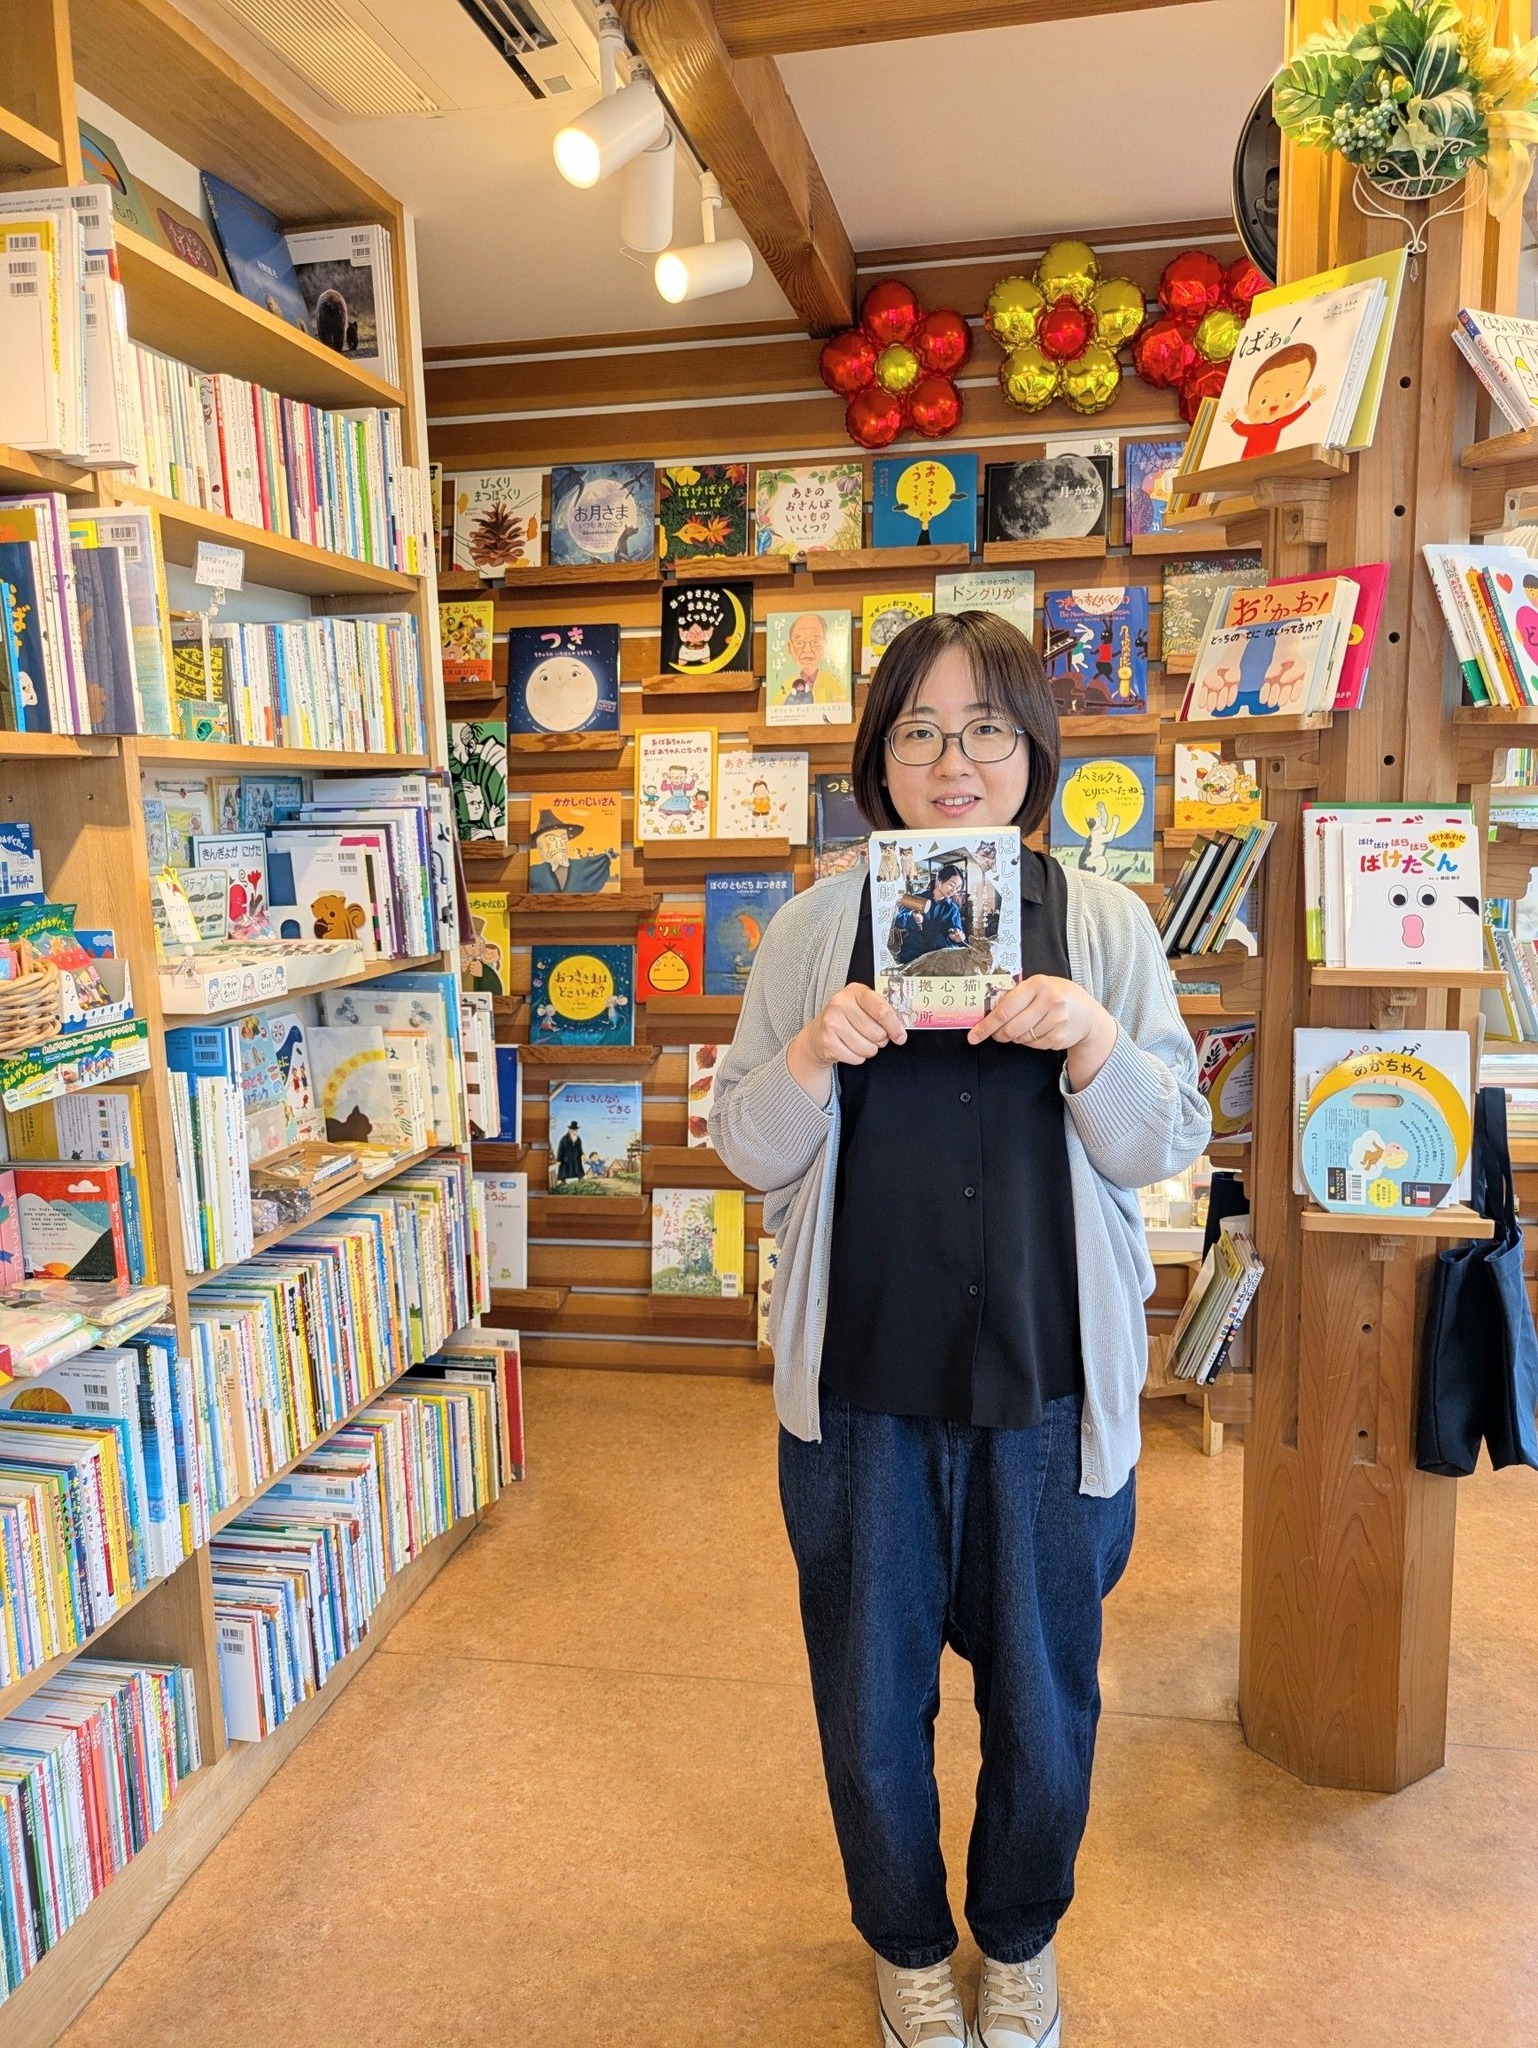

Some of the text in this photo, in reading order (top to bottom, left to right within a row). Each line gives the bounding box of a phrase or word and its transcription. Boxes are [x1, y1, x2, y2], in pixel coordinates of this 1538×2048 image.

[678, 484, 730, 498] ばけばけ
[791, 487, 825, 499] あきの
[925, 464, 938, 508] おつきみ
[1060, 485, 1102, 498] 月のかがく
[574, 504, 629, 522] お月さま
[786, 499, 833, 512] おさんぽ
[785, 512, 831, 523] いいもの
[953, 586, 1016, 602] ドングリが
[540, 627, 584, 650] つき
[1210, 619, 1324, 645] どっちの てに はいってるか？
[1071, 768, 1123, 783] 月へミルクを
[553, 797, 616, 807] かかしのじいさん
[1358, 837, 1429, 851] ばけ ばけ ばら ばら
[1428, 831, 1466, 843] ばけあわせ
[202, 845, 262, 861] きんぎょが にげた
[1360, 848, 1458, 875] ばけたくん
[710, 880, 788, 889] ぼくの ともだち おつきさま
[998, 837, 1017, 968] はしもとみお
[555, 969, 607, 985] おつきさまは
[941, 979, 955, 1006] 心の
[963, 979, 977, 1006] 猫は
[918, 979, 933, 1023] 拠り所
[1354, 1058, 1427, 1081] あかちゃん
[564, 1093, 620, 1104] おじいさんなら
[606, 1104, 631, 1114] できる
